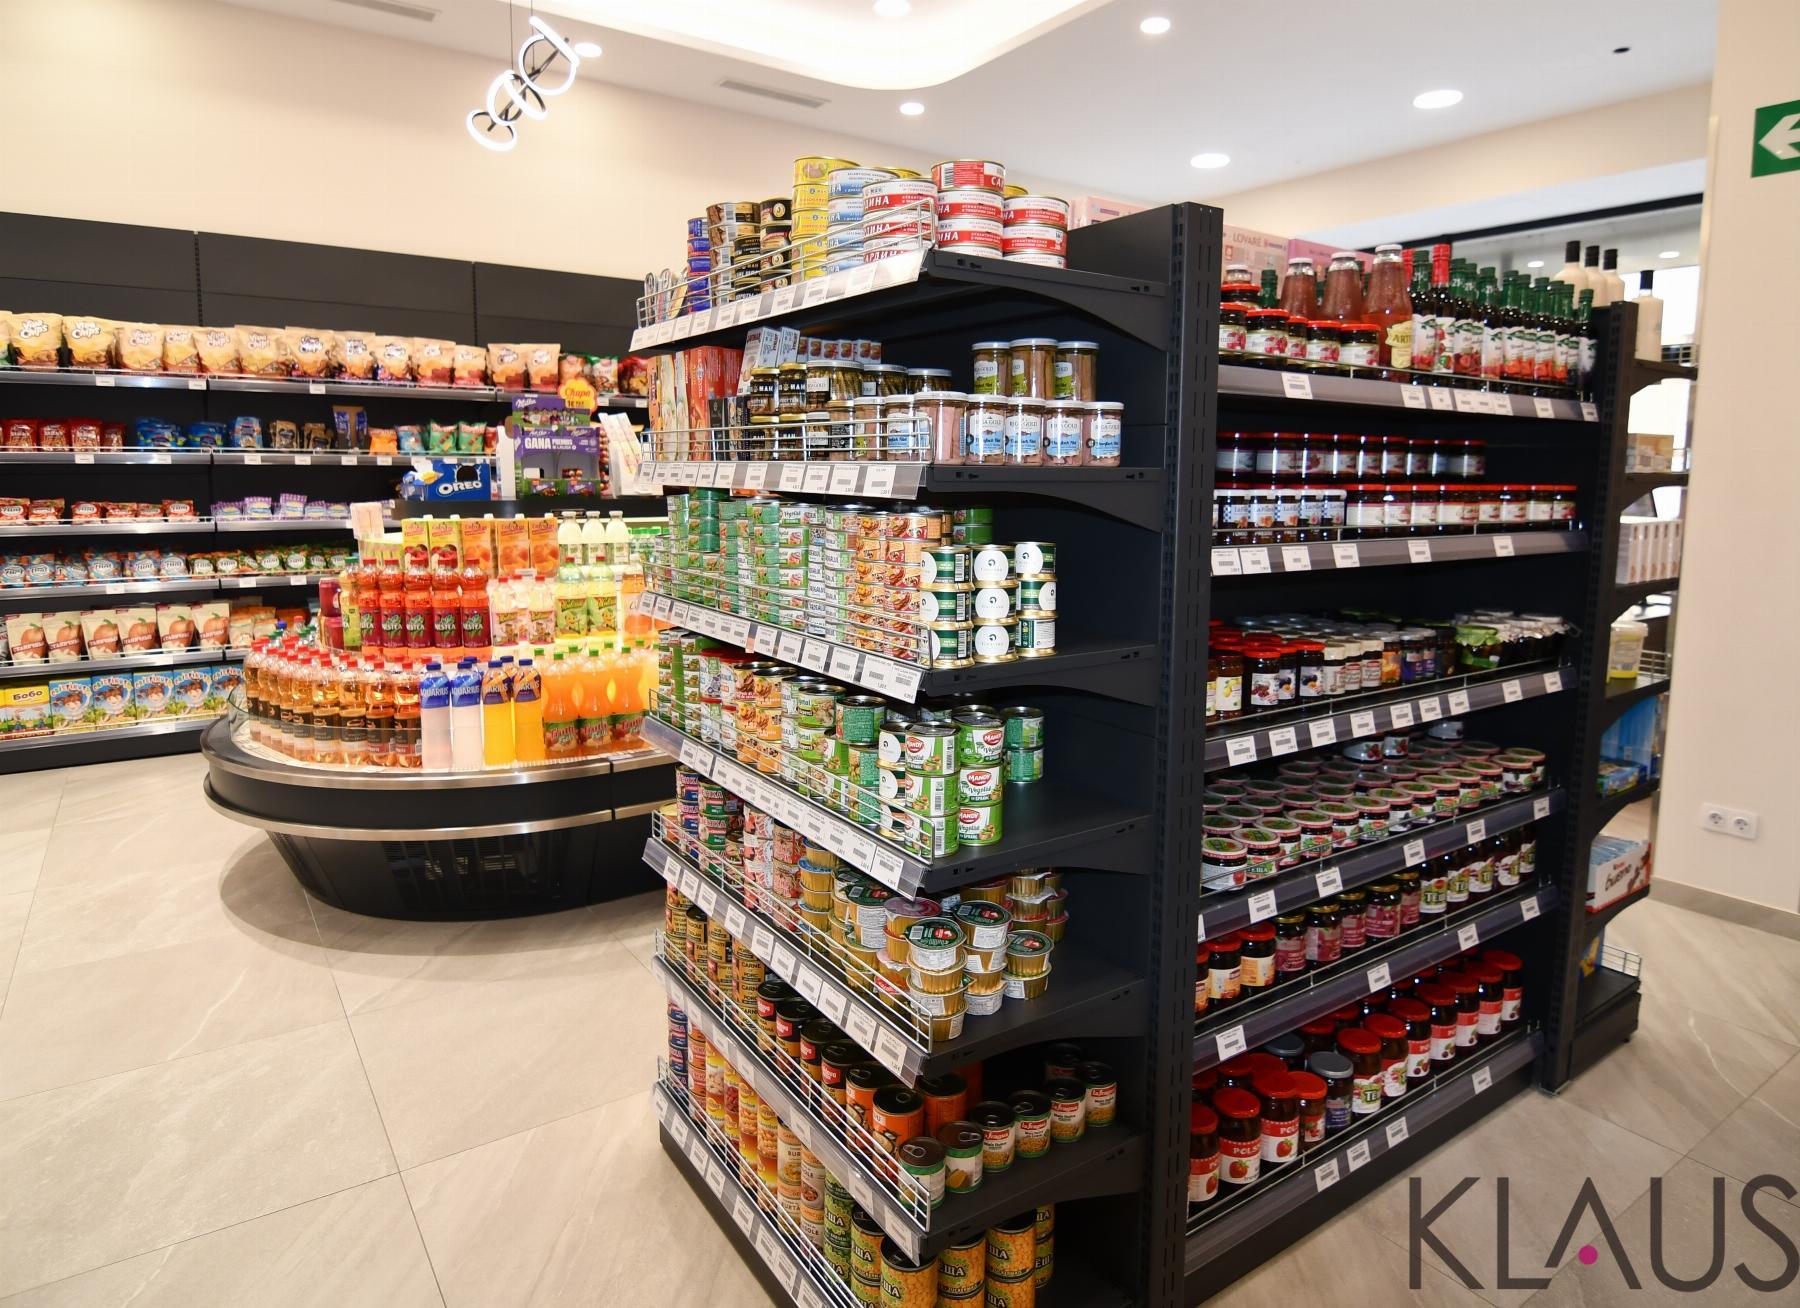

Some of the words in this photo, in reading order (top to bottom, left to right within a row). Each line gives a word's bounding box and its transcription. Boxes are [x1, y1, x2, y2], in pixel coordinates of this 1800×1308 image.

[524, 437, 552, 450] GANA
[436, 480, 483, 496] OREO
[13, 690, 43, 701] Бобо
[967, 773, 992, 783] MANDY
[968, 786, 992, 796] Vegetal
[1604, 864, 1633, 891] bueno
